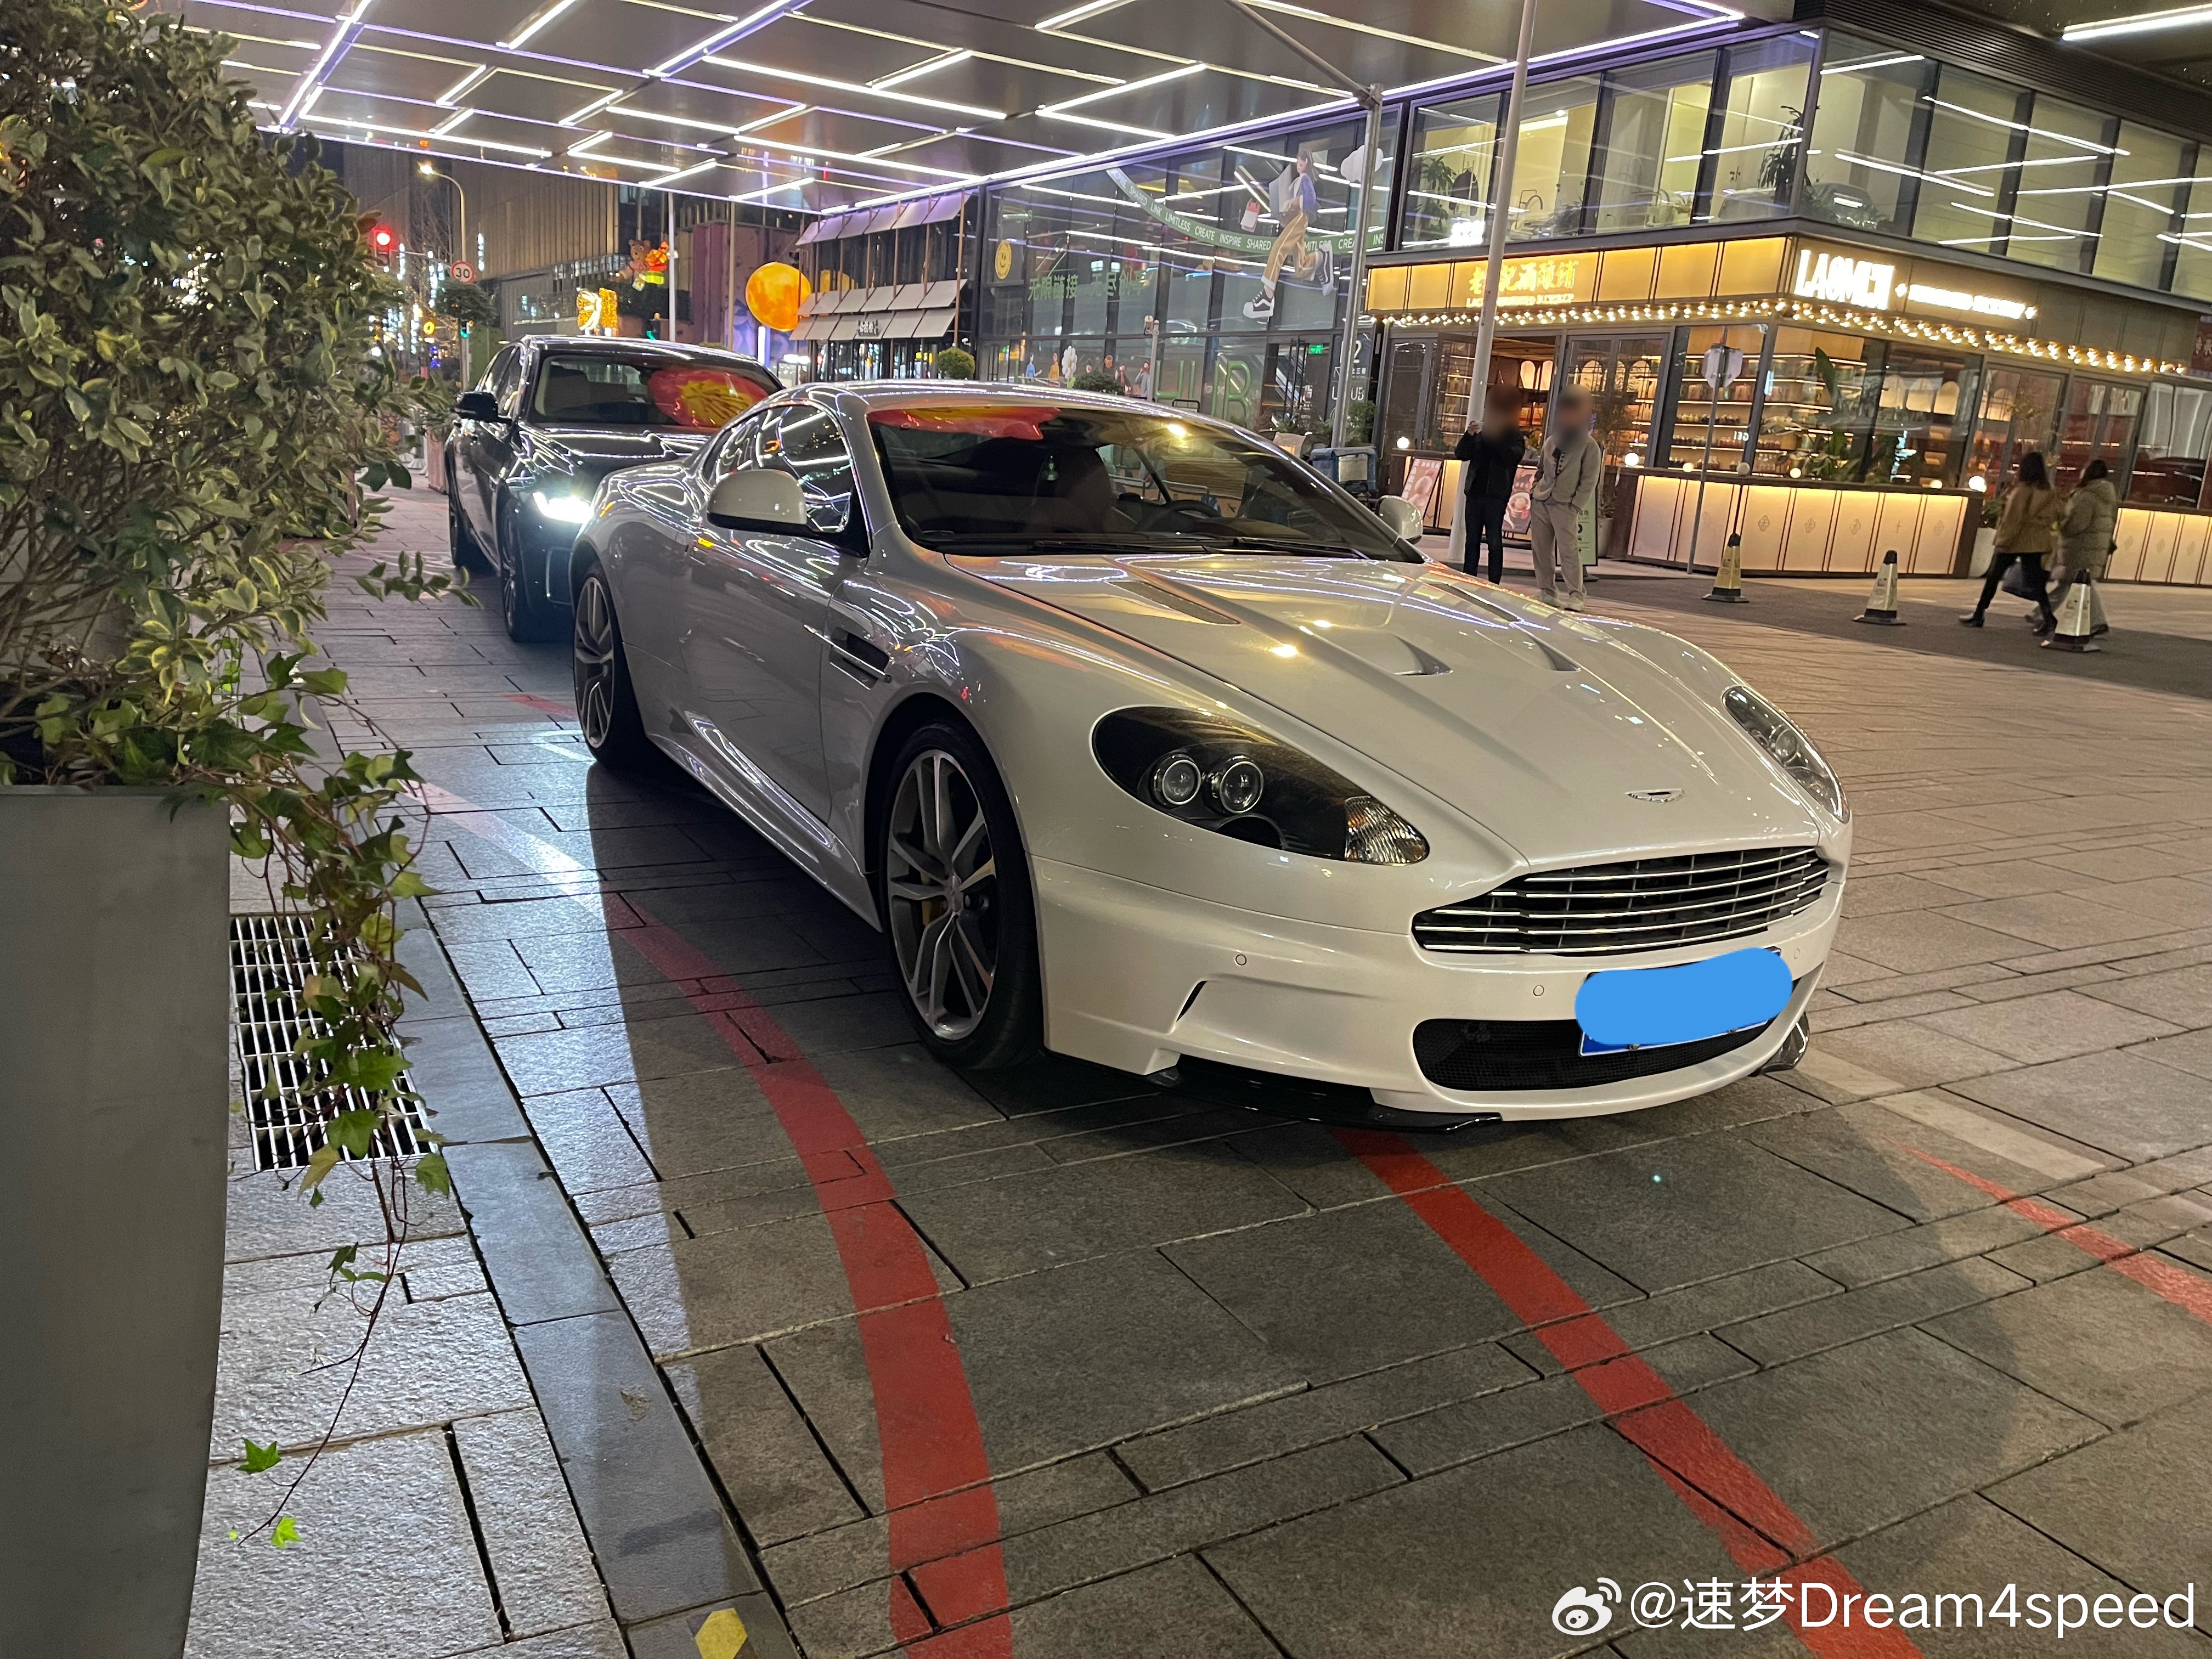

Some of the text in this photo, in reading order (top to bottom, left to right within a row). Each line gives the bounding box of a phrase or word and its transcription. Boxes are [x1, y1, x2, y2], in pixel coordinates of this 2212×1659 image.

[1130, 185, 1148, 206] SHARED
[1150, 202, 1163, 217] LINK
[1165, 212, 1191, 232] LIMITLESS
[1194, 225, 1215, 241] CREATE
[1220, 233, 1242, 247] INSPIRE
[1246, 238, 1272, 251] SHARED
[456, 268, 470, 278] 30
[1028, 274, 1079, 301] 无限链接
